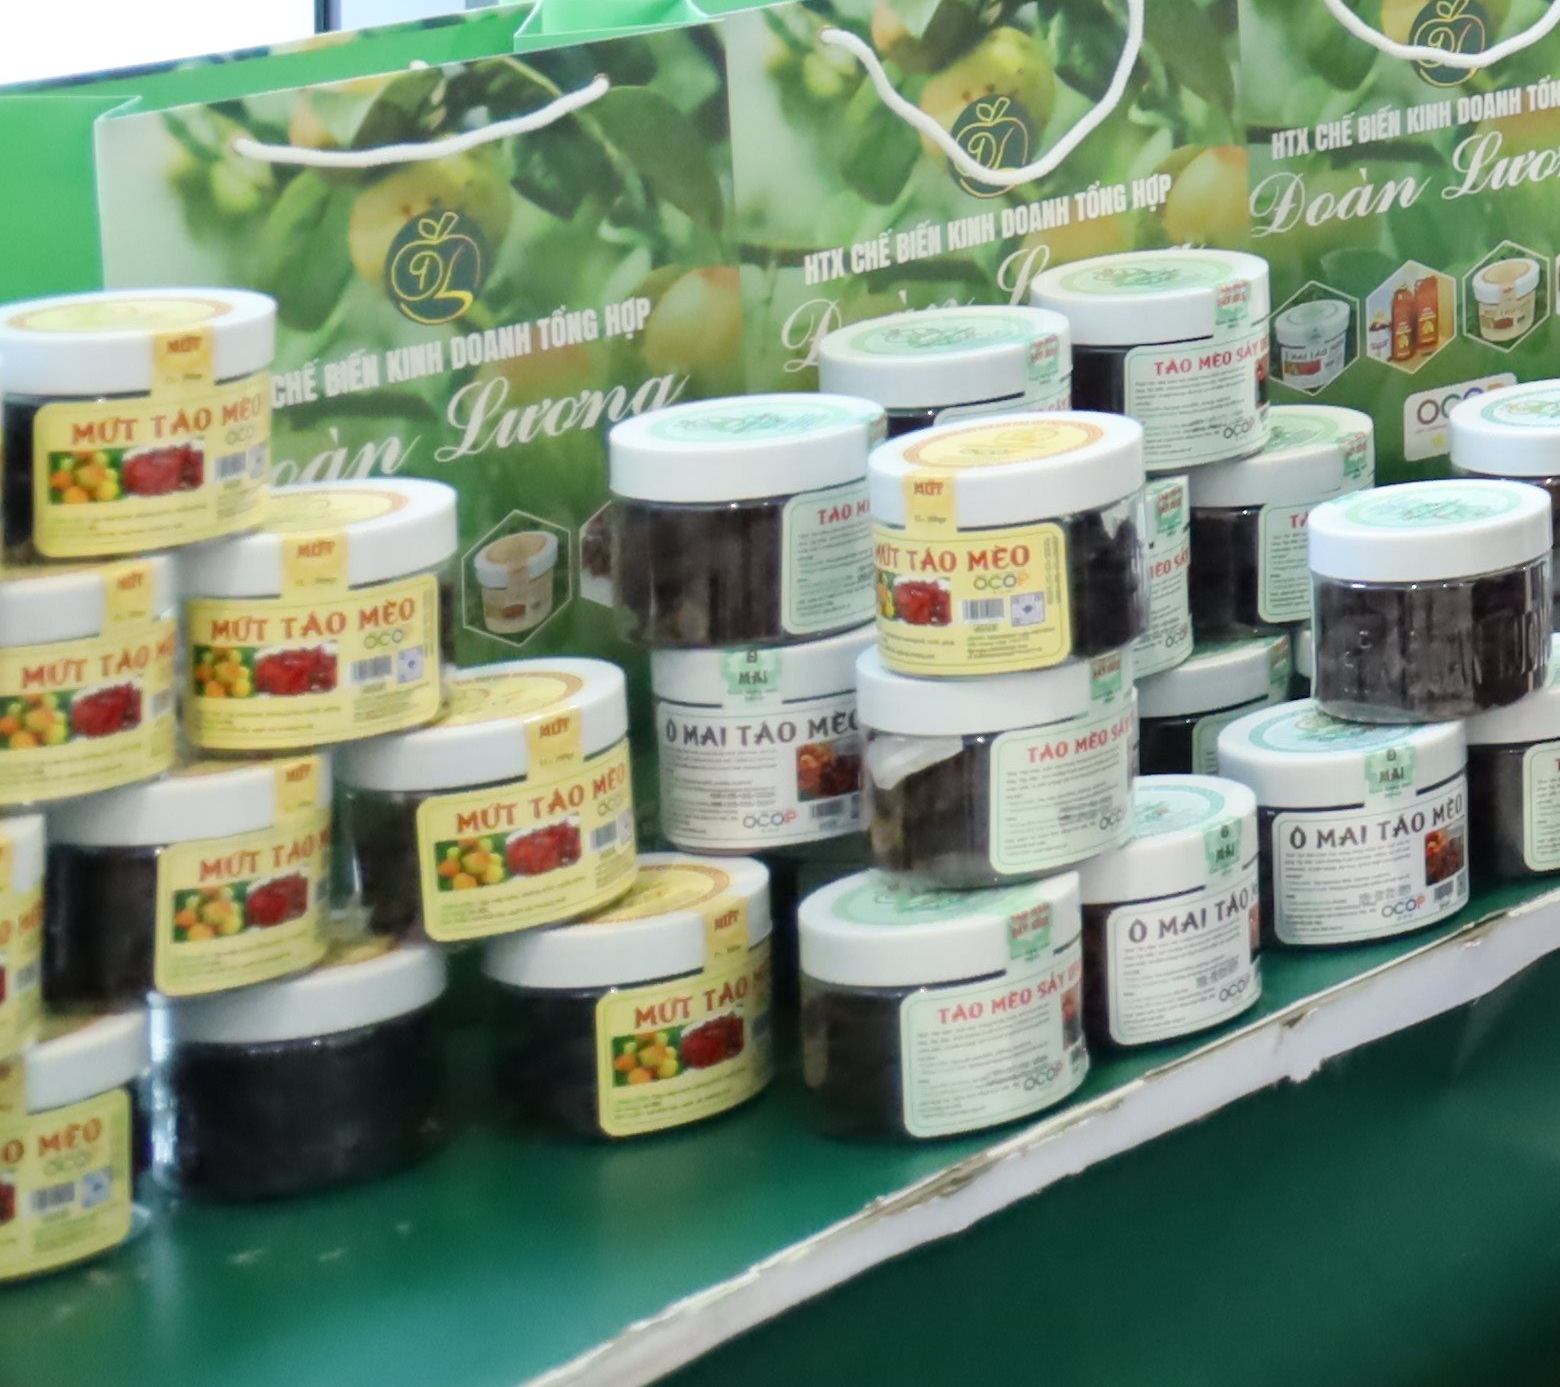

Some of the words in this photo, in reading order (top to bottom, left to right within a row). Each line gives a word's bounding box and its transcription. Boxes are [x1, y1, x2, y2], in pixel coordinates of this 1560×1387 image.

[1272, 128, 1309, 160] HTX
[1315, 115, 1354, 151] CHẾ
[1358, 105, 1401, 143] BIẾN
[1407, 101, 1451, 133] KINH
[1458, 86, 1521, 123] DOANH
[1249, 168, 1431, 237] Đoàn
[805, 251, 845, 285] HTX
[851, 232, 892, 274] CHẾ
[897, 220, 941, 263] BIẾN
[948, 213, 995, 251] KINH
[1002, 196, 1069, 239] DOANH
[1075, 180, 1125, 221] TỔNG
[1133, 173, 1172, 214] HỢP
[325, 349, 379, 397] BIẾN
[386, 341, 443, 383] KINH
[451, 322, 532, 370] DOANH
[537, 305, 597, 350] TỔNG
[605, 296, 651, 339] HỢP
[1154, 358, 1192, 376] TÁO
[1199, 352, 1232, 370] MÈO
[71, 416, 138, 445] MỨT
[151, 407, 212, 438] TÁO
[272, 428, 421, 489] oàn
[817, 503, 850, 525] TÁO
[906, 547, 956, 573] TÁO
[967, 545, 1030, 572] MÈO
[211, 615, 269, 641] MỨT
[281, 612, 346, 639] TÁO
[359, 598, 415, 631] MÈO
[666, 718, 676, 743] Ô
[683, 724, 726, 747] MAI
[736, 721, 796, 747] TÁO
[1027, 741, 1069, 763] TÁO
[456, 803, 518, 833] MỨT
[529, 785, 584, 819] TÁO
[743, 810, 797, 829] OCOP
[1290, 826, 1306, 850] Ô
[1316, 825, 1367, 849] MAI
[1377, 811, 1425, 841] TÁO
[1129, 918, 1147, 943] Ô
[1158, 908, 1207, 938] MAI
[1215, 887, 1249, 922] TÁO
[1381, 893, 1425, 918] OCOP
[635, 996, 693, 1028] MỨT
[938, 1003, 983, 1024] TÁO
